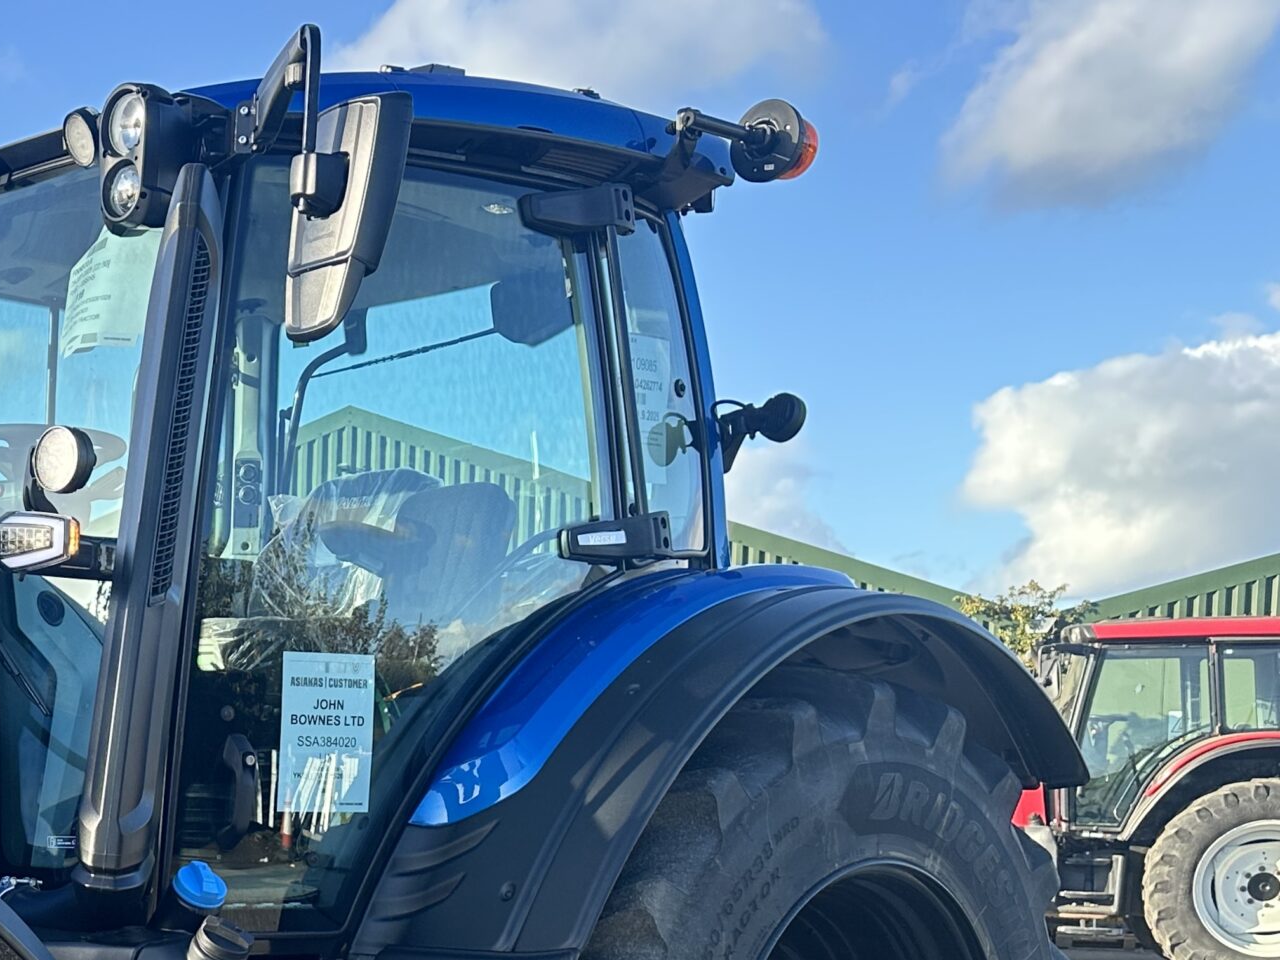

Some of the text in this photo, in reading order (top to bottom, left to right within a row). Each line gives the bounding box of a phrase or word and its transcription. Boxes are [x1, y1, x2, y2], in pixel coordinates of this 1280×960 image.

[328, 678, 368, 689] CUSTOMER
[313, 699, 345, 711] JOHN
[290, 714, 365, 727] BOWNES LTD
[297, 735, 357, 748] SSA384020
